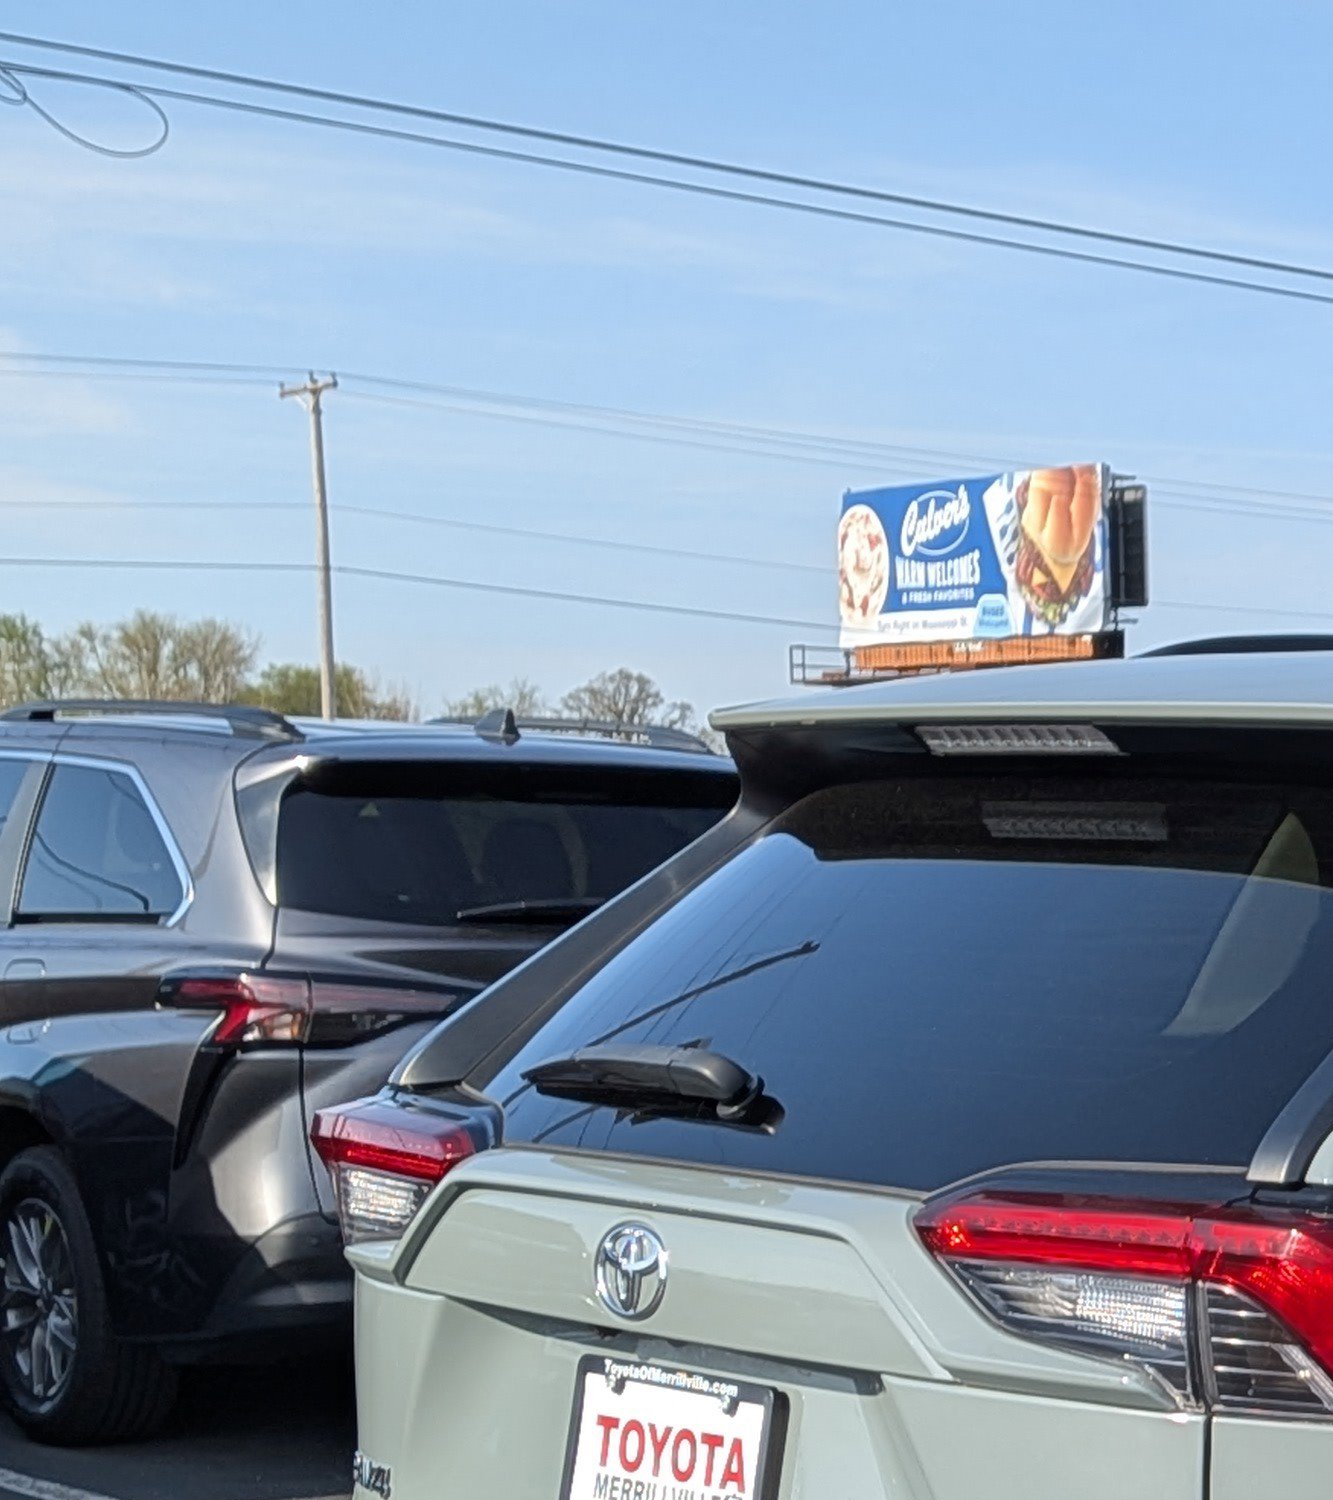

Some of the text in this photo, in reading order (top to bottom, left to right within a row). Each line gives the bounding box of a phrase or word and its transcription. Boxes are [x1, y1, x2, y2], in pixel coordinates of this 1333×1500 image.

[901, 484, 970, 557] Culver's
[927, 549, 980, 588] WELCOMES
[604, 1358, 738, 1398] ToyotaOfMerrillville.com
[596, 1414, 746, 1494] TOYOTA
